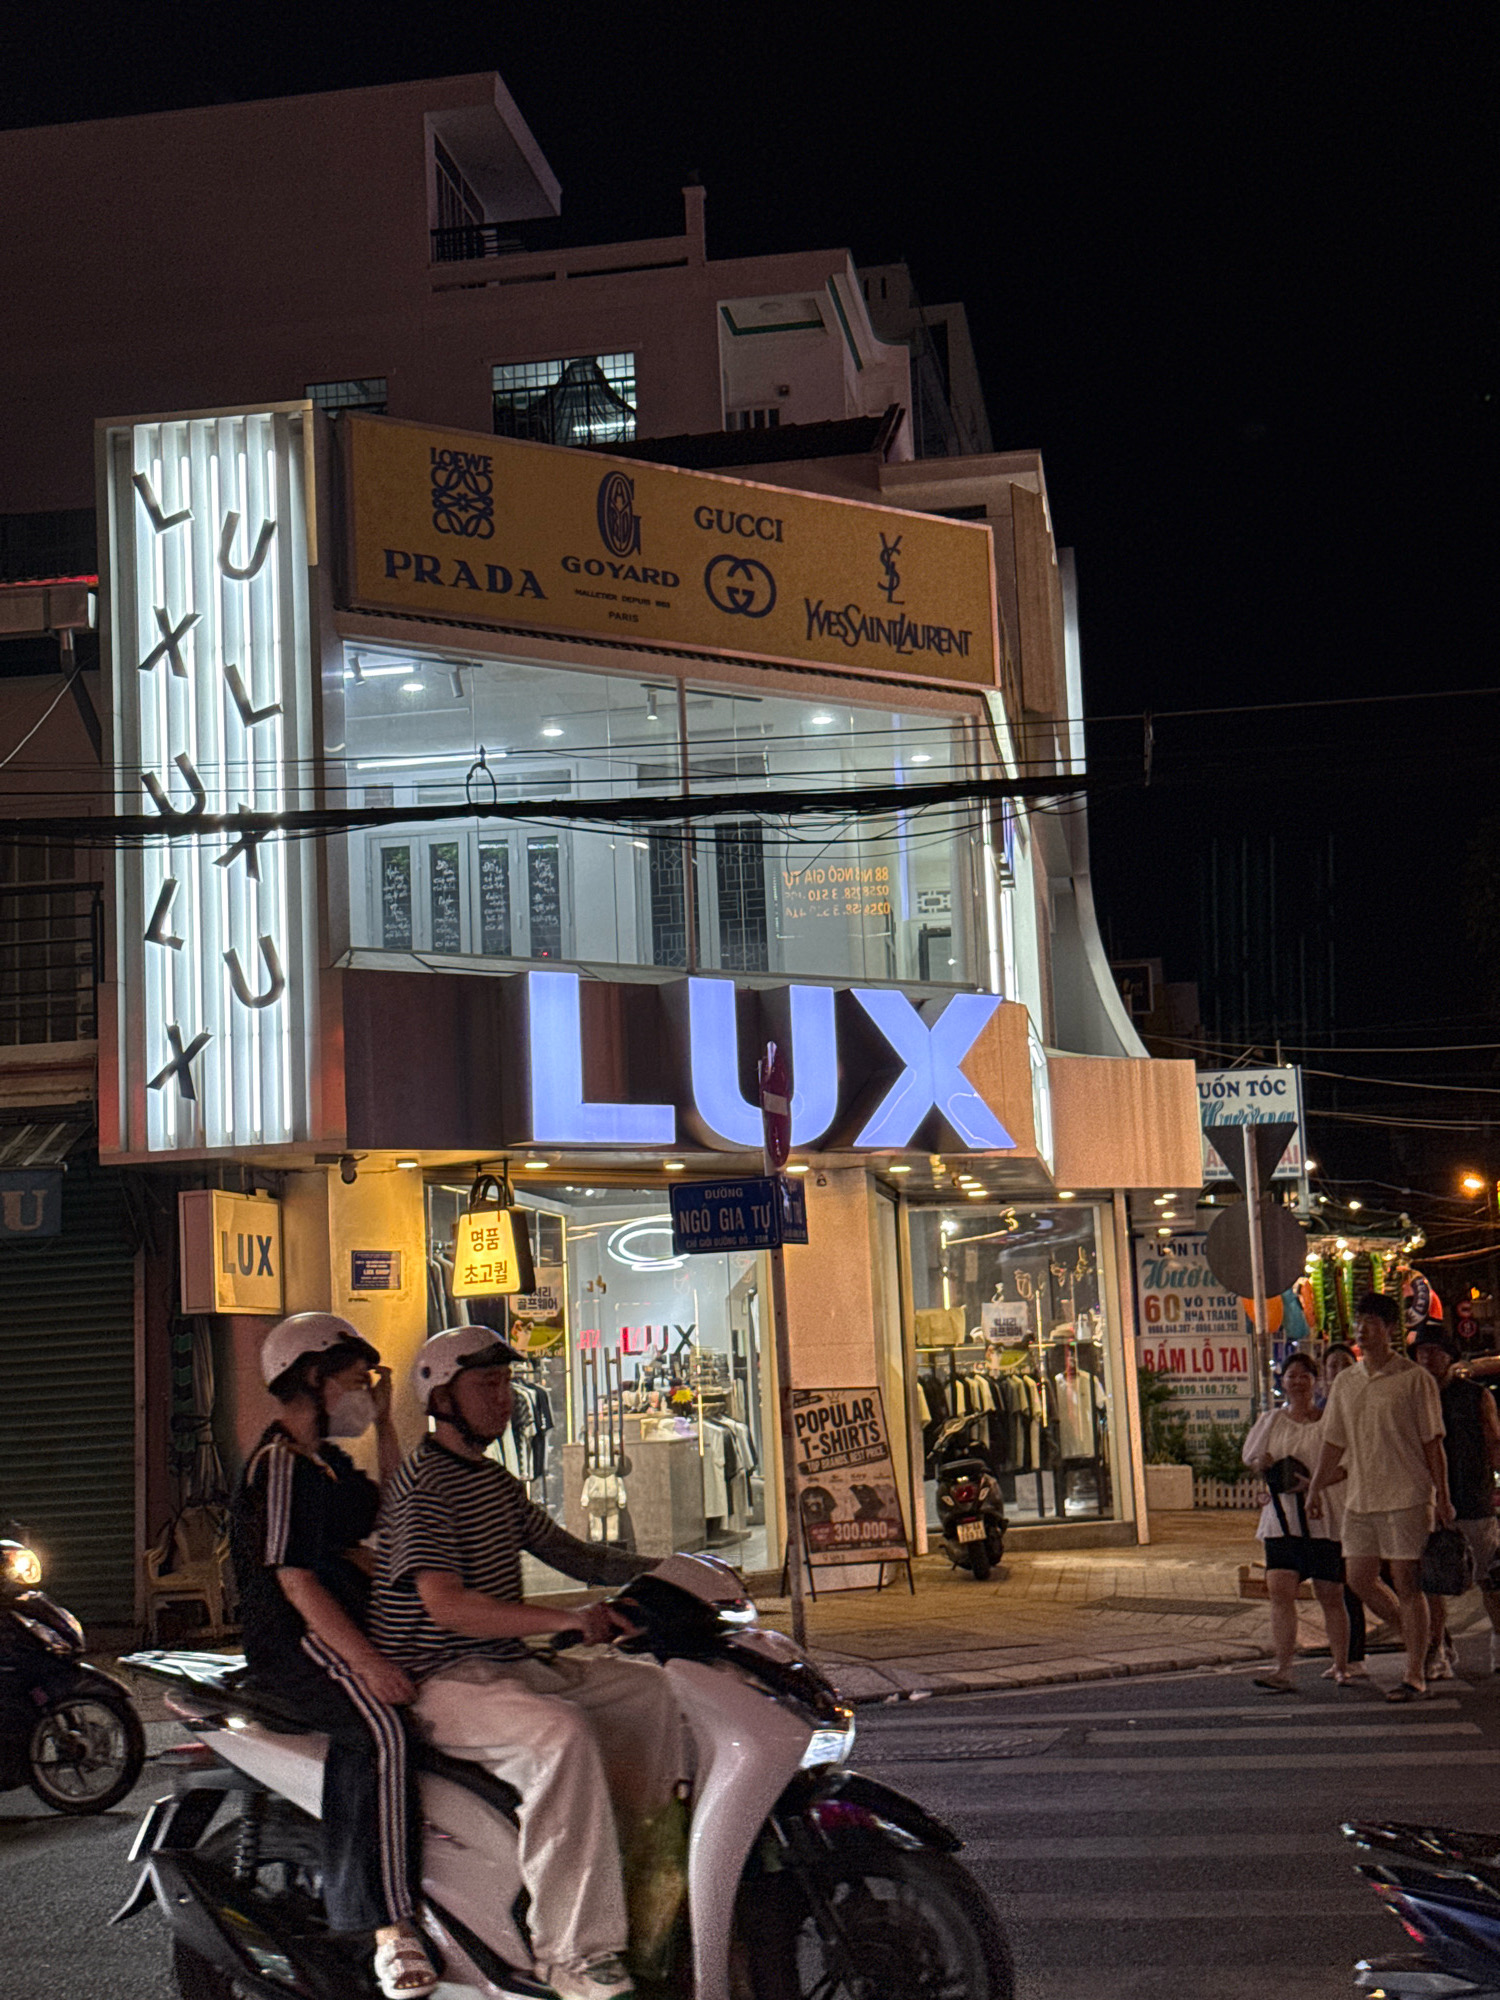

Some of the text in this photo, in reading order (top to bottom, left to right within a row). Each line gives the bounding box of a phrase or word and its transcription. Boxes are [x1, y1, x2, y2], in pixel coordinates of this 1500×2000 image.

[430, 447, 493, 474] LOEWE
[694, 505, 783, 543] GUCCI
[383, 549, 549, 600] PRADA
[561, 555, 681, 588] GOYARD
[608, 611, 639, 623] PARIS
[528, 970, 1016, 1149] LUX
[1198, 1074, 1286, 1099] UỐN TÓC
[1280, 1144, 1299, 1165] AI
[704, 1186, 743, 1199] ĐƯỜNG
[680, 1203, 711, 1233] NGÔ
[719, 1207, 745, 1232] GIA
[750, 1202, 771, 1233] TỰ
[221, 1230, 274, 1277] LUX
[471, 1227, 500, 1252] 명품
[464, 1260, 508, 1285] 초고퀄
[517, 1297, 558, 1311] 골프웨어
[1144, 1294, 1180, 1323] 60
[1206, 1309, 1238, 1321] TRANG
[622, 1324, 696, 1356] LUX
[1143, 1339, 1187, 1374] BẤM
[1192, 1338, 1215, 1373] LỖ
[1219, 1347, 1248, 1373] TAI
[794, 1397, 876, 1438] POPULAR
[800, 1420, 880, 1460] T-SHIRTS
[807, 1462, 820, 1472] TOP
[834, 1521, 888, 1541] 300.000
